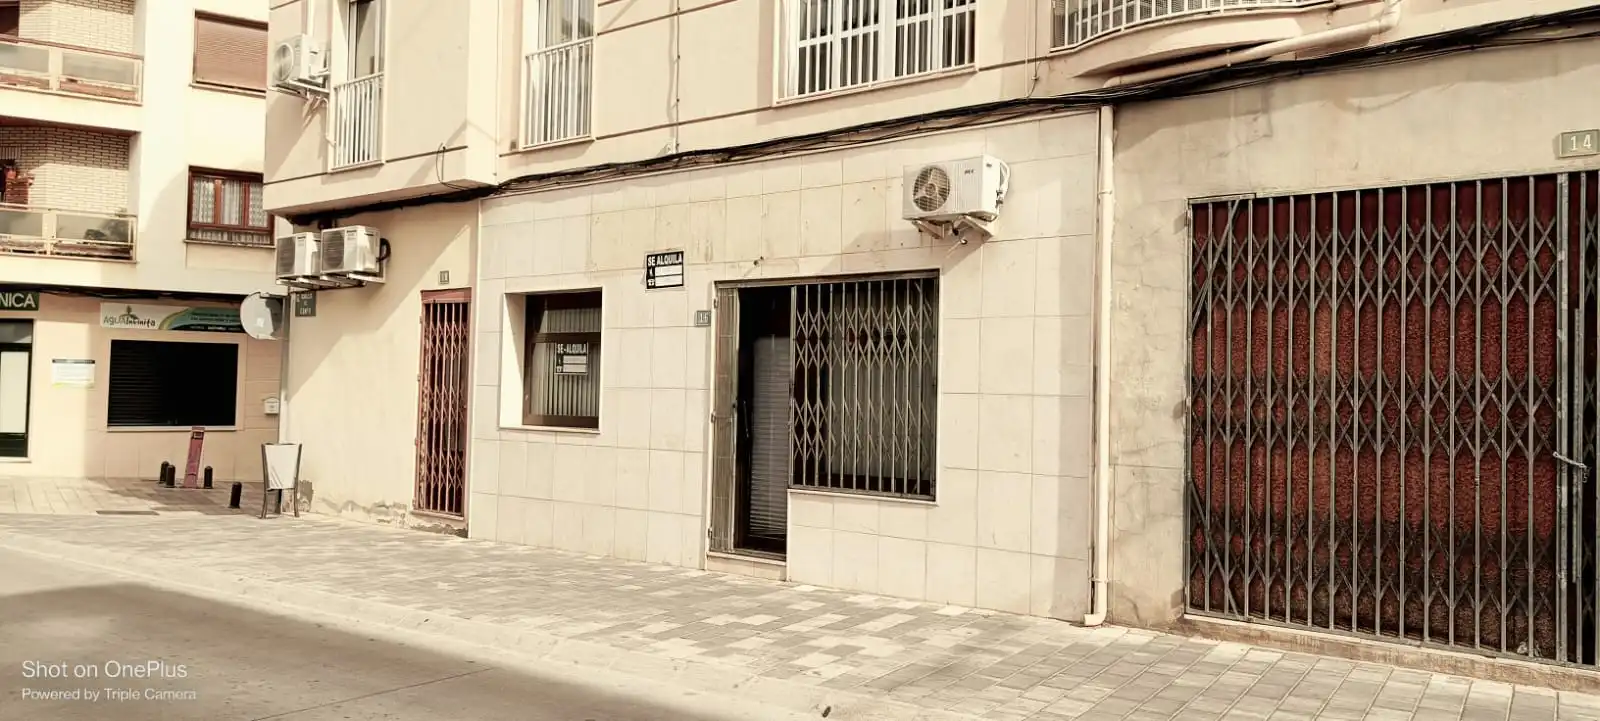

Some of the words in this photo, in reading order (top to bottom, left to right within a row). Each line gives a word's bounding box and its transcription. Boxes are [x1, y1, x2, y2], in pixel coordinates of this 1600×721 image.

[1570, 134, 1592, 151] 14
[647, 256, 656, 267] SE
[657, 253, 682, 265] ALQUILA
